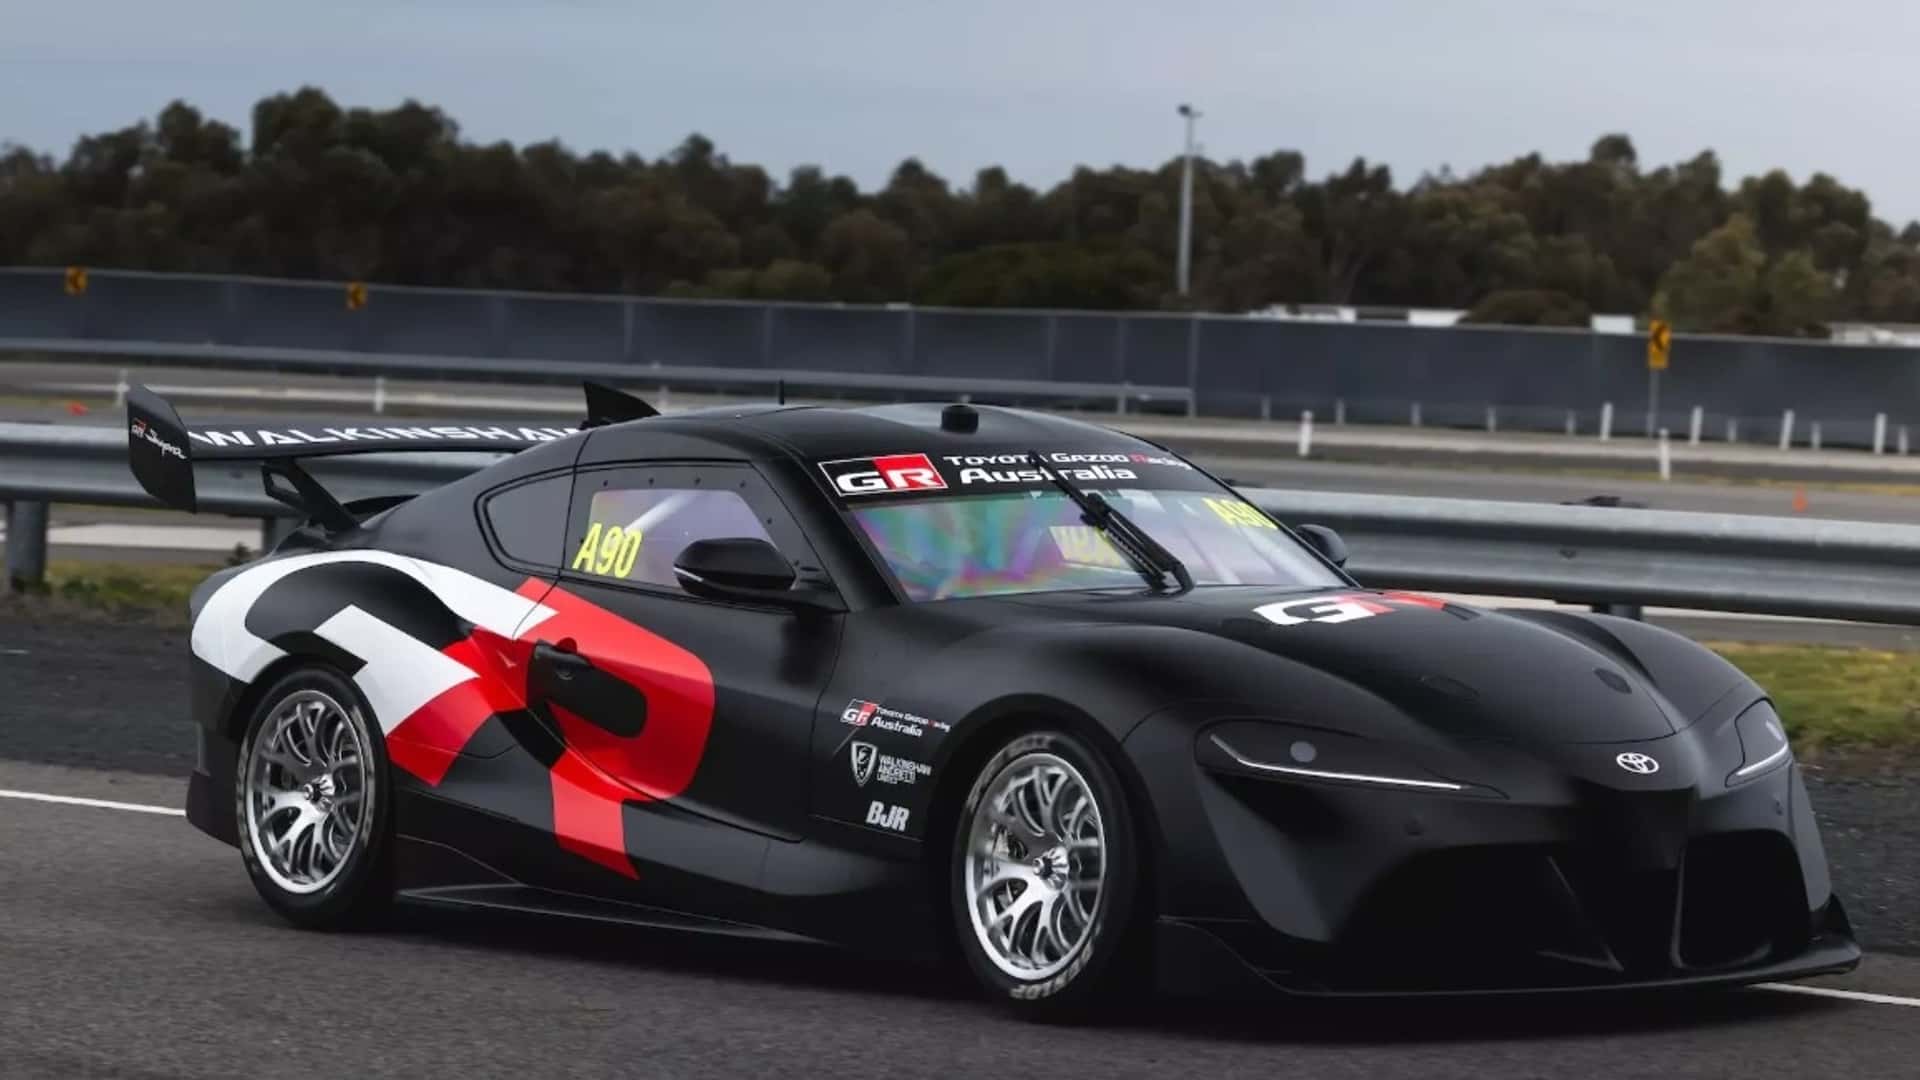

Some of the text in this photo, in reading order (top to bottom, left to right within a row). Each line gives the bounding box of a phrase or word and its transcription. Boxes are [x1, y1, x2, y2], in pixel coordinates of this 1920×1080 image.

[836, 468, 942, 492] GR
[959, 464, 1138, 484] Australia
[571, 522, 643, 578] A90
[871, 716, 923, 737] Australia
[866, 800, 910, 831] BJR
